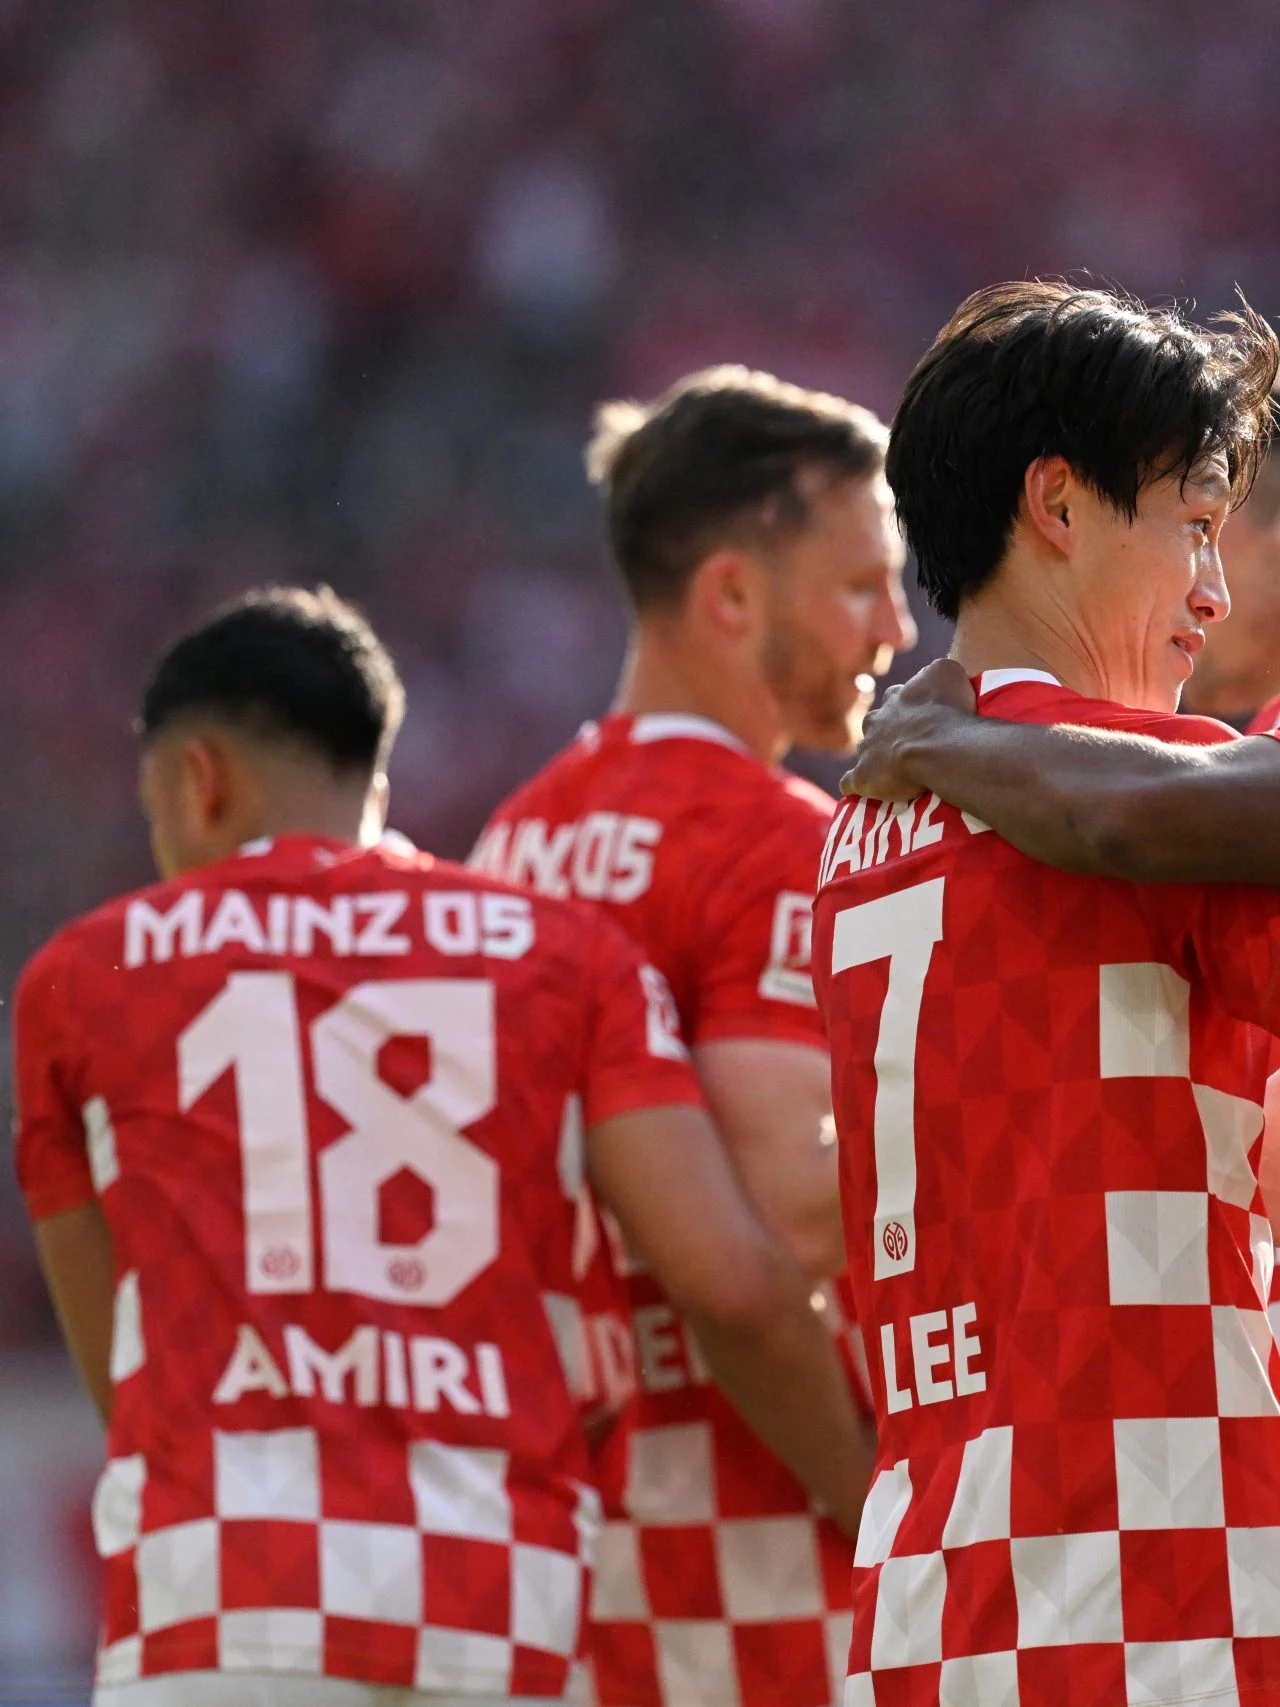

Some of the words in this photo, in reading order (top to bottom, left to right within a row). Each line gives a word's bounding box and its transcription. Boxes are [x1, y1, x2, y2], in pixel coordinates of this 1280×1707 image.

[126, 891, 410, 968] MAINZ
[423, 890, 536, 961] 05
[831, 877, 946, 1282] 7
[176, 971, 500, 1307] 18
[213, 1326, 510, 1418] AMIRI
[880, 1302, 987, 1415] LEE
